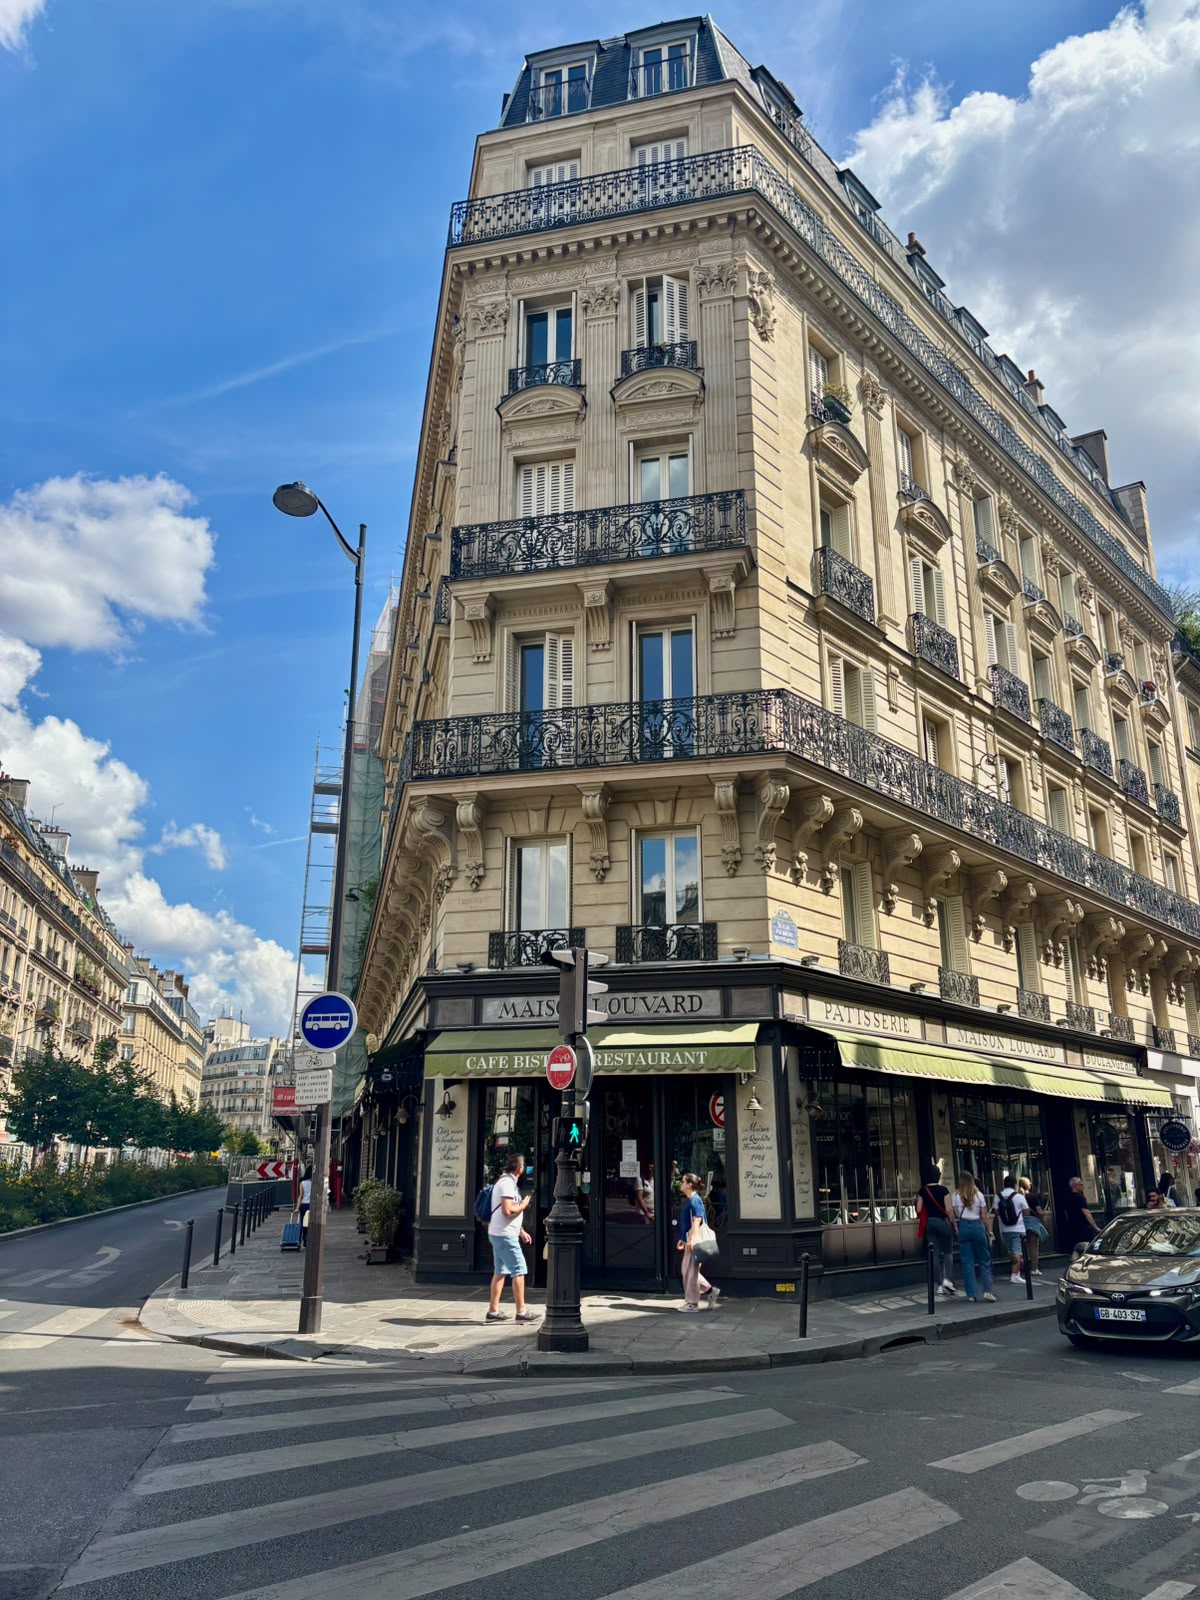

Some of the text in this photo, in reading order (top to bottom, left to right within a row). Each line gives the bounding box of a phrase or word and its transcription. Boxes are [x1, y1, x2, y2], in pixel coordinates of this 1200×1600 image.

[498, 994, 703, 1019] MAIS LOUVARD
[824, 1002, 910, 1034] PATISSERIE
[957, 1027, 1057, 1059] MAISON LOUVARD
[466, 1055, 509, 1070] CAFE
[513, 1054, 550, 1069] BIST
[593, 1051, 708, 1067] RESTAURANT
[1085, 1051, 1136, 1073] BOULANGERIE
[1101, 1309, 1141, 1320] GB-403-SZ
